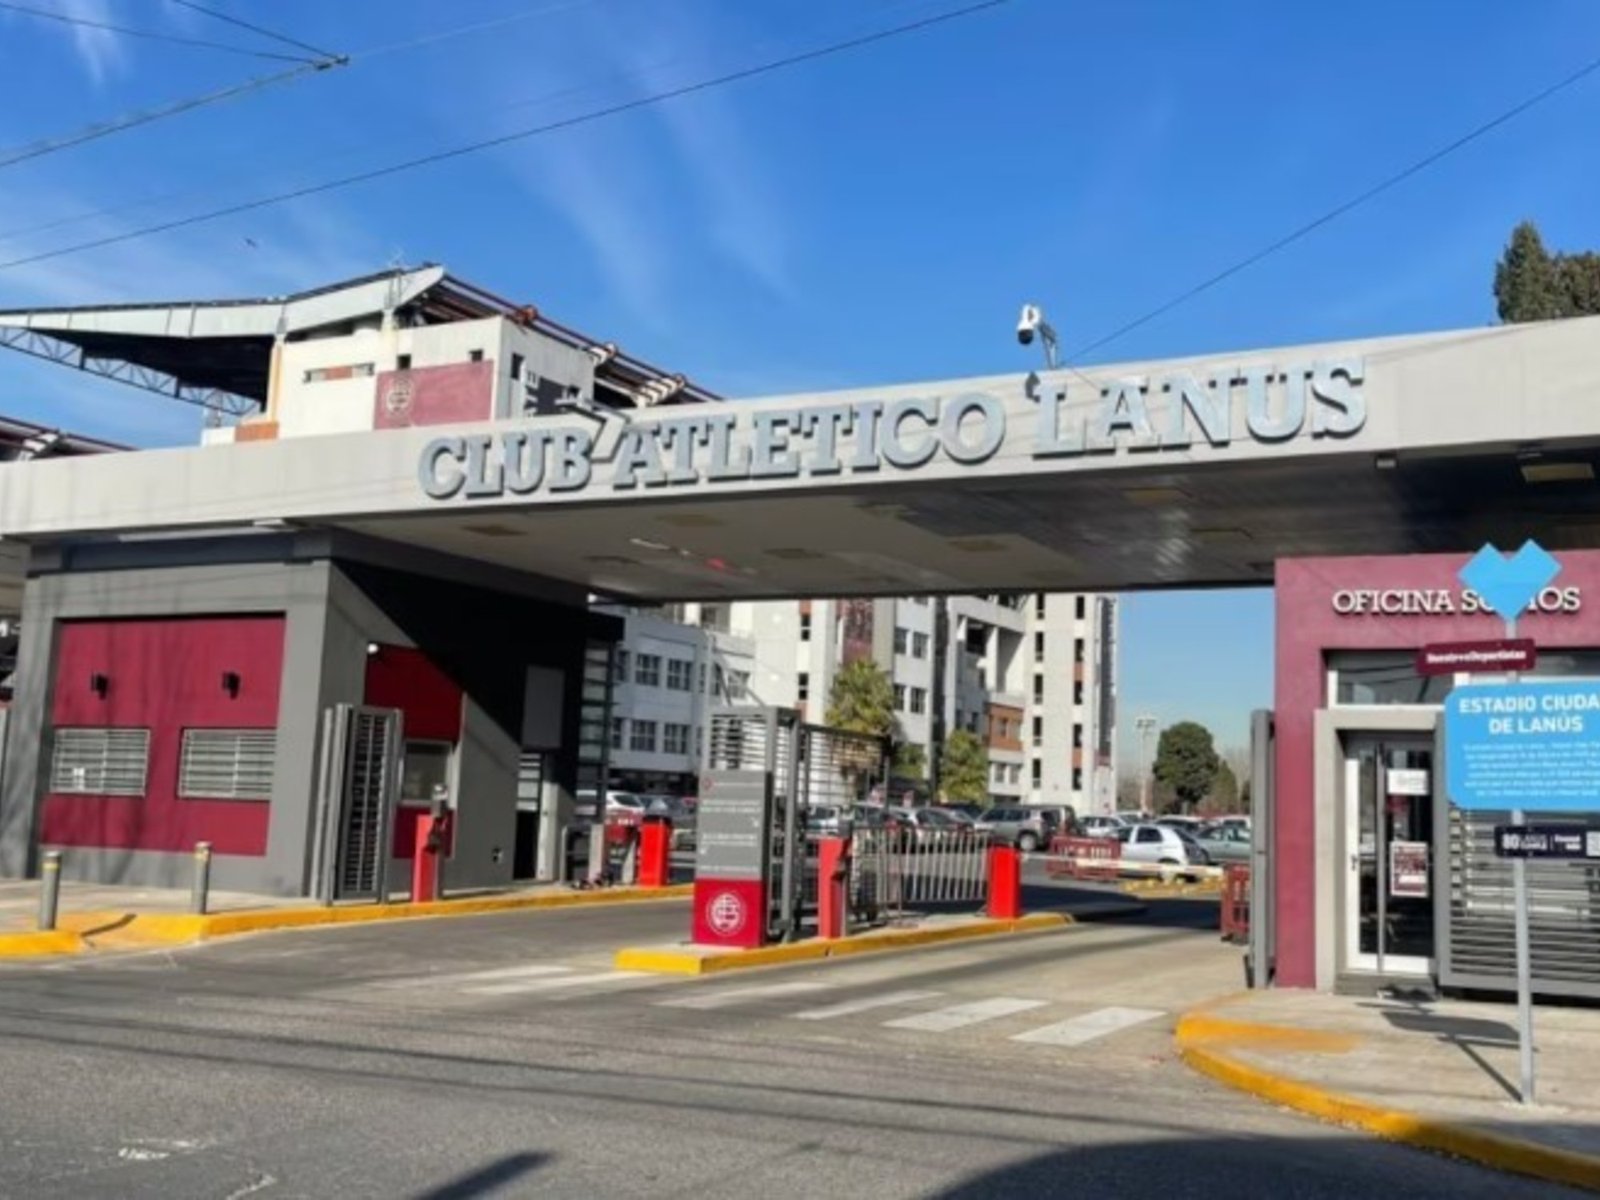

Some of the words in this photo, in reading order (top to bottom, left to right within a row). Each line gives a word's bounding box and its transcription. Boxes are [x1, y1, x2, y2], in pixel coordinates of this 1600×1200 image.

[418, 425, 593, 500] CLUB
[612, 391, 1006, 491] ATLETICO
[1031, 355, 1367, 461] LANUS
[1332, 589, 1456, 613] OFICINA
[1461, 587, 1581, 613] SOS
[1459, 695, 1538, 714] ESTADIO
[1541, 692, 1600, 712] CIUDA
[1488, 718, 1514, 735] DE
[1517, 711, 1583, 733] LANÚS
